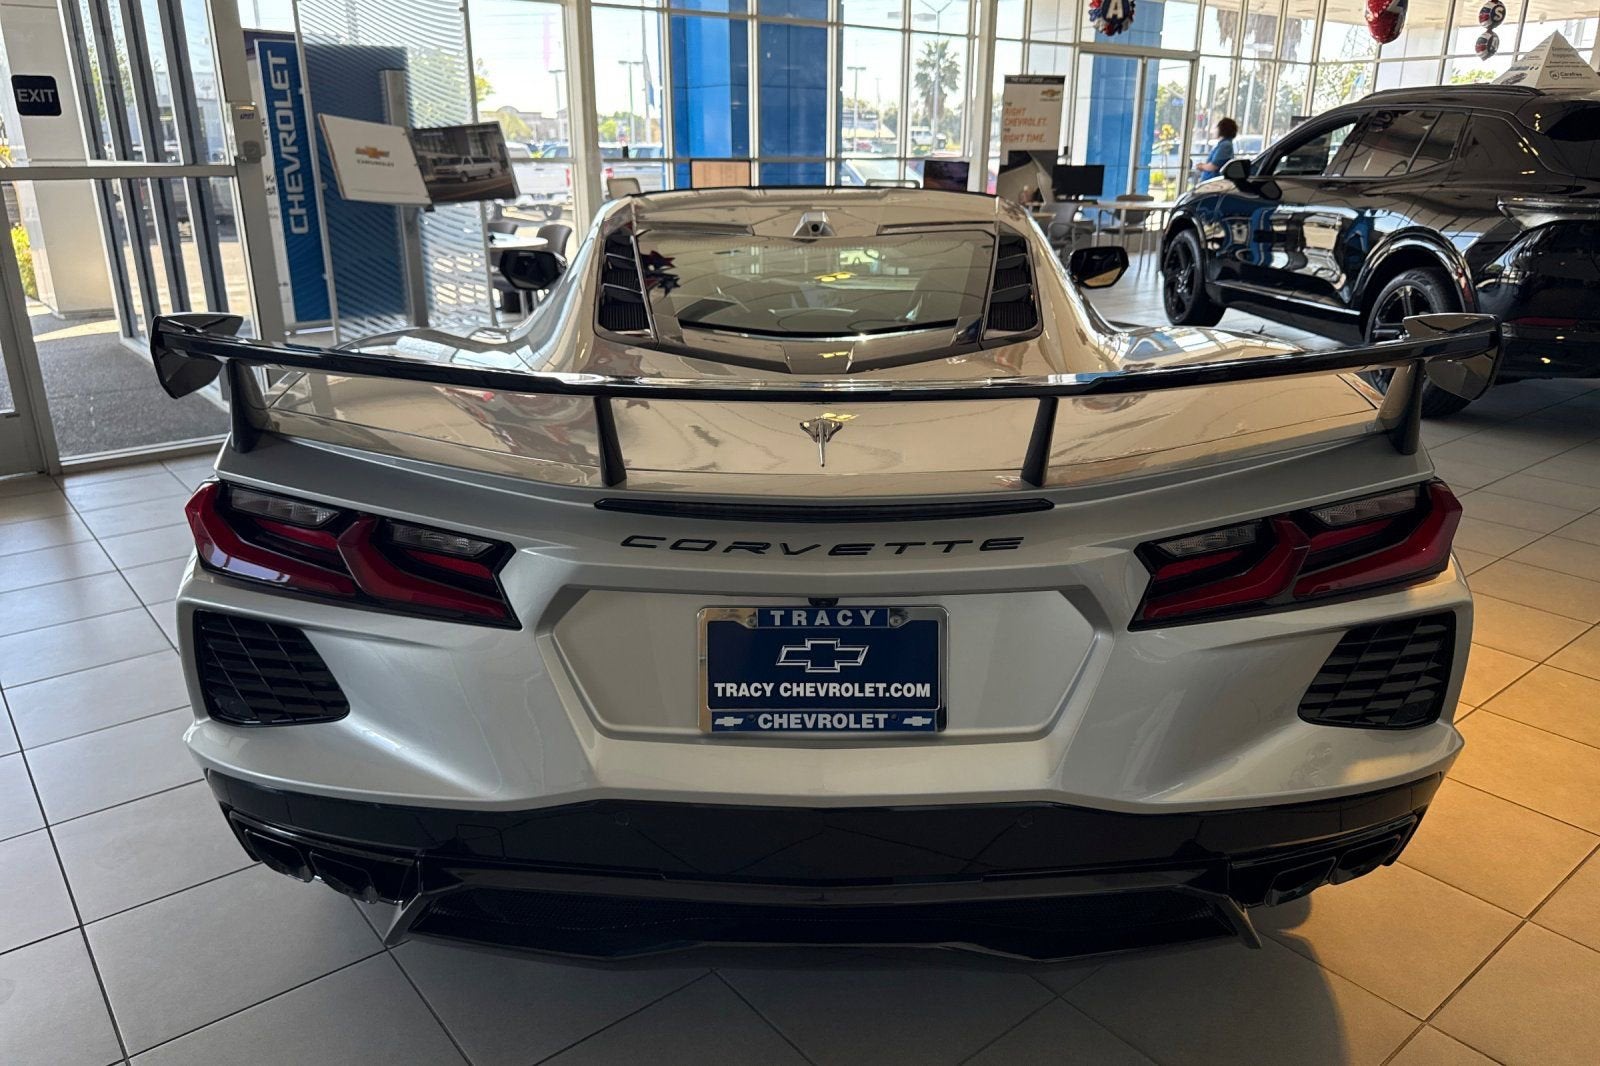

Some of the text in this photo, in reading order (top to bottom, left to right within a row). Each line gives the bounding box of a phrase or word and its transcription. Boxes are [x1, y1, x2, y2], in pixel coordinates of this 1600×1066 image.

[1106, 0, 1125, 19] A
[1494, 6, 1504, 21] S
[17, 88, 54, 103] EXIT
[1005, 107, 1025, 116] RIGHT
[267, 50, 309, 235] CHEVROLET
[1003, 133, 1024, 142] RIGHT
[620, 535, 1025, 555] CORVETTE
[770, 610, 877, 626] TRACY
[714, 682, 931, 698] TRACY CHEVROLET.COM
[758, 713, 888, 729] CHEVROLET
